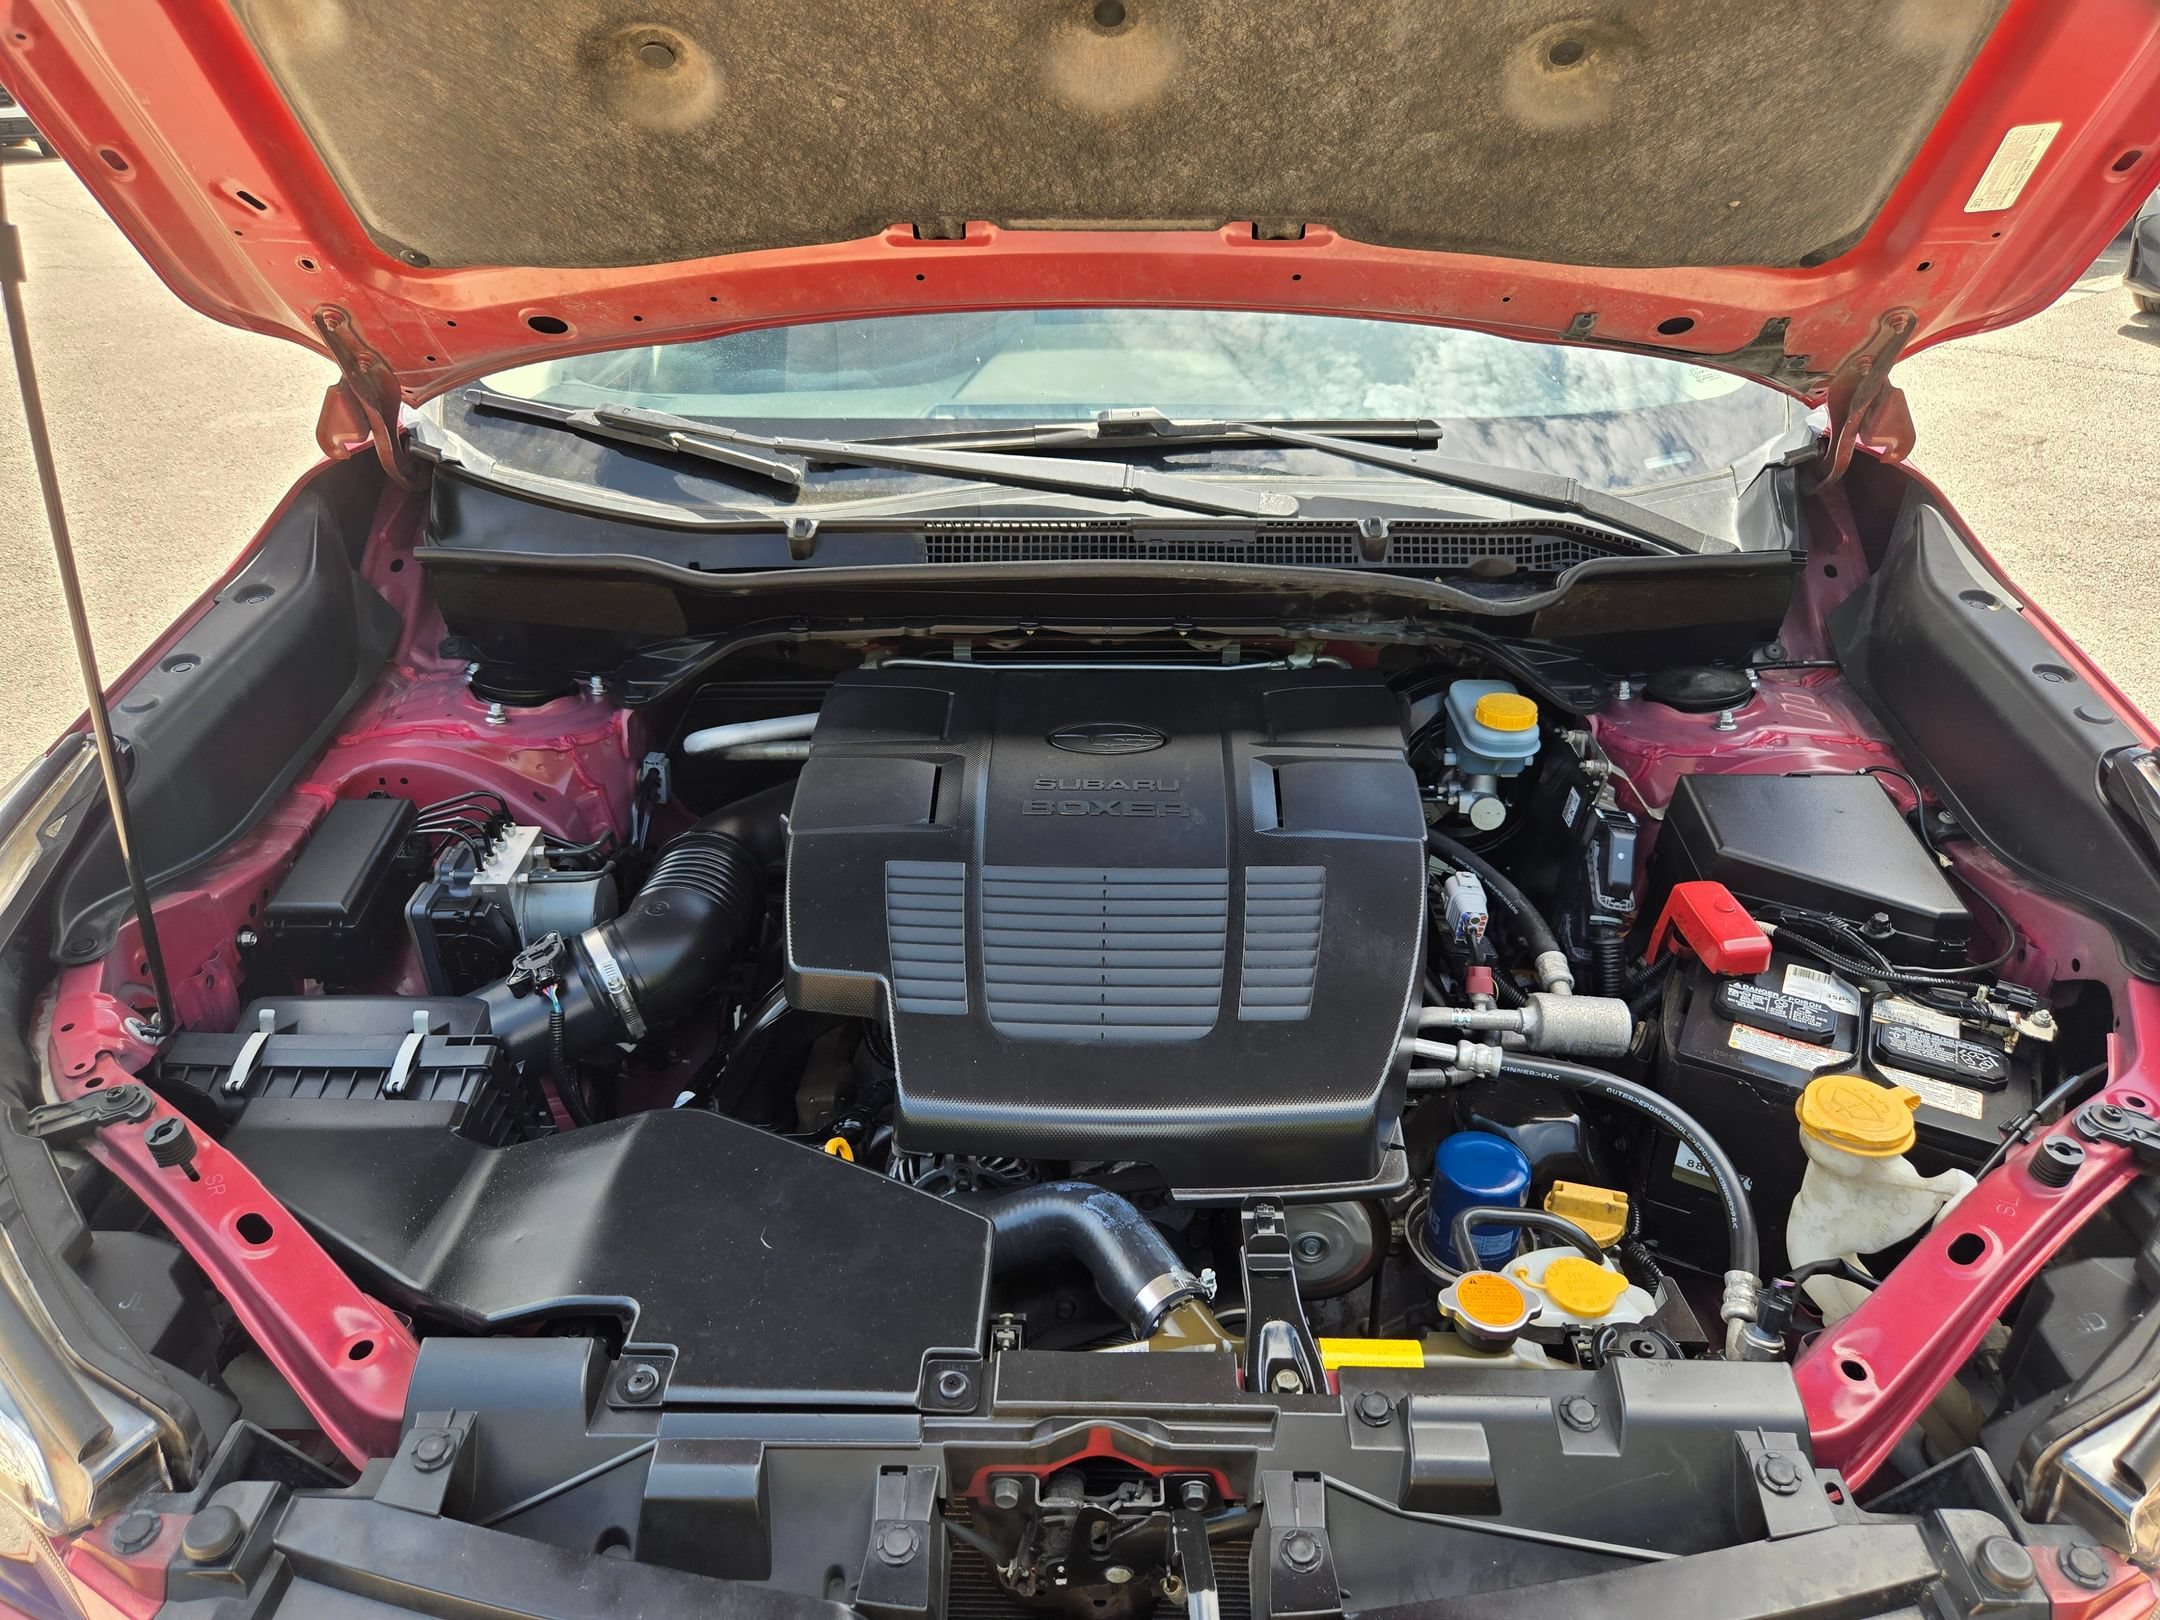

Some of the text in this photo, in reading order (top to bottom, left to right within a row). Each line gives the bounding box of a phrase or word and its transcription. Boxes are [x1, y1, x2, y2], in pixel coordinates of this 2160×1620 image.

[1033, 778, 1180, 792] SUBARU
[1022, 799, 1191, 818] BOXER
[1742, 984, 1780, 998] DANGER
[1788, 996, 1822, 1009] POISON
[205, 1173, 226, 1198] SR
